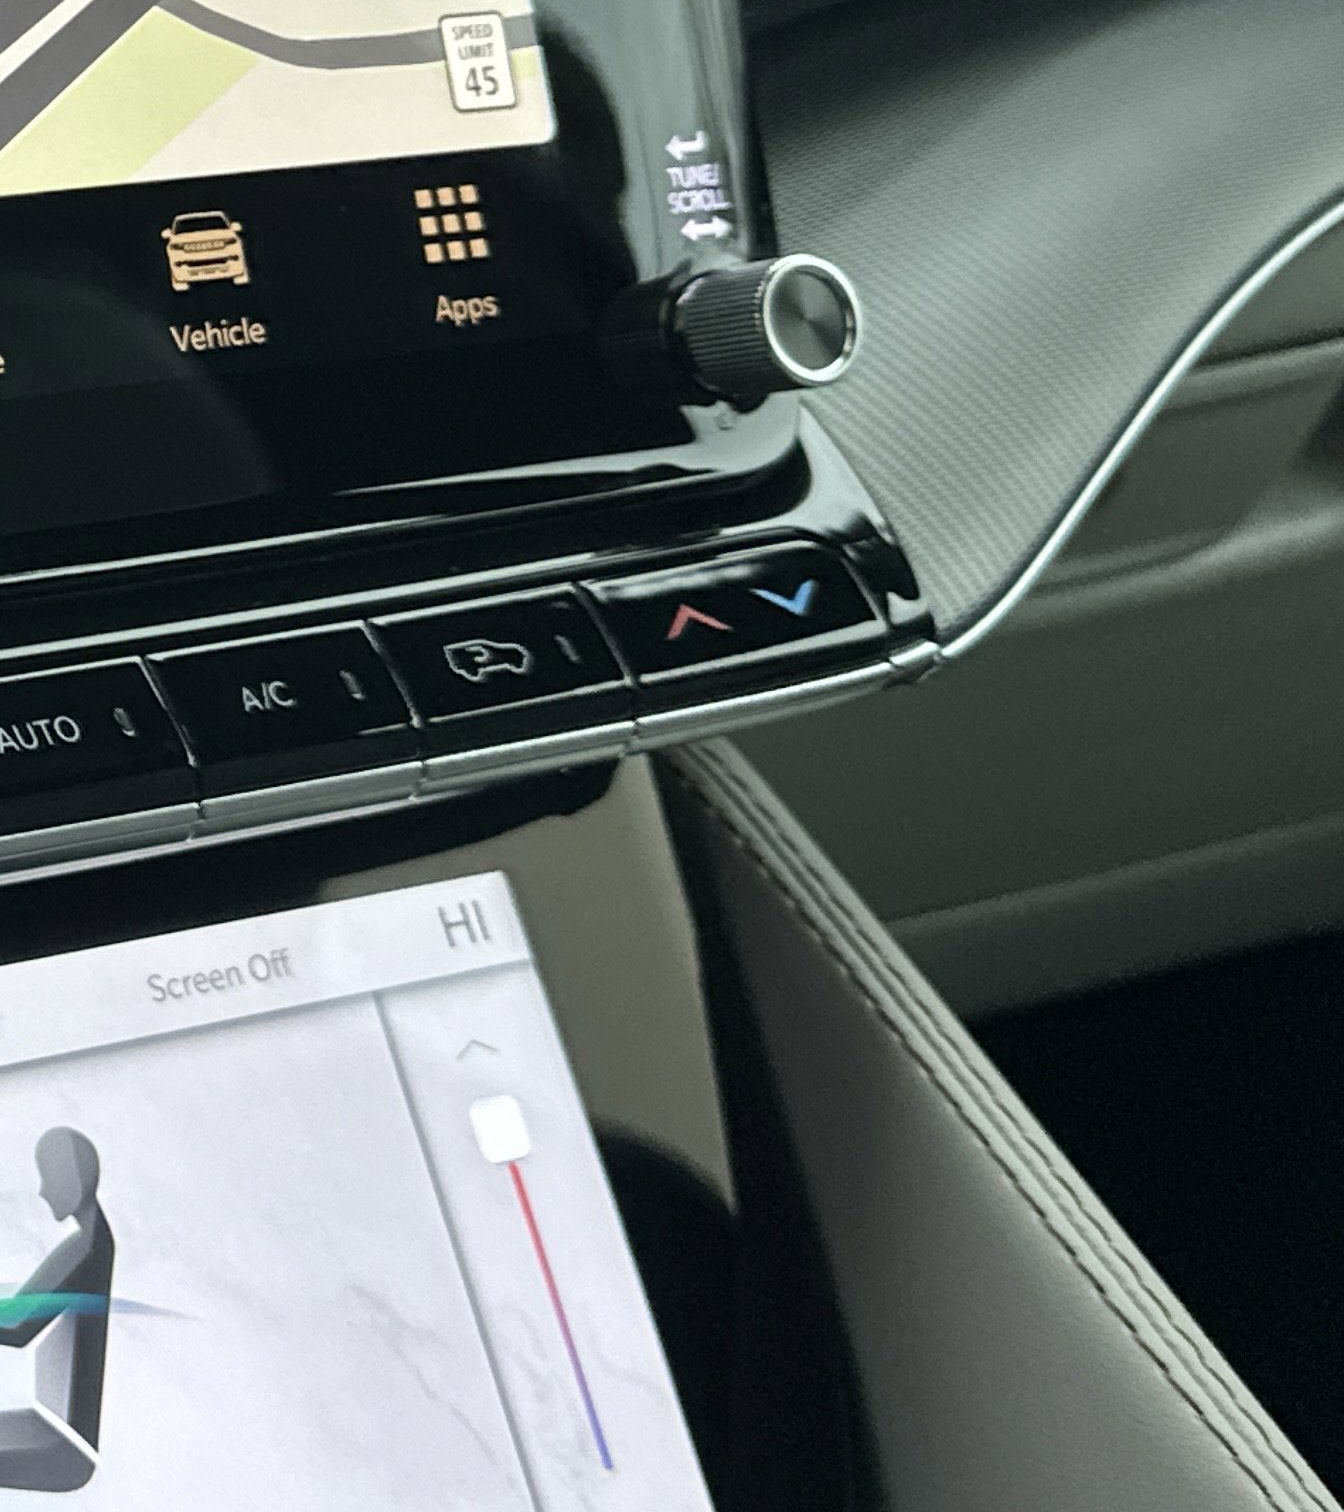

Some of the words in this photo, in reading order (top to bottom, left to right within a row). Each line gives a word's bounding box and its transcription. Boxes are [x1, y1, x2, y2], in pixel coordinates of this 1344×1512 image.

[465, 65, 499, 96] 45
[434, 293, 500, 327] Apps
[170, 318, 267, 353] Vehicle
[241, 678, 297, 714] A/C
[436, 901, 491, 950] HI
[146, 956, 244, 1003] Screen
[248, 946, 294, 984] Off
